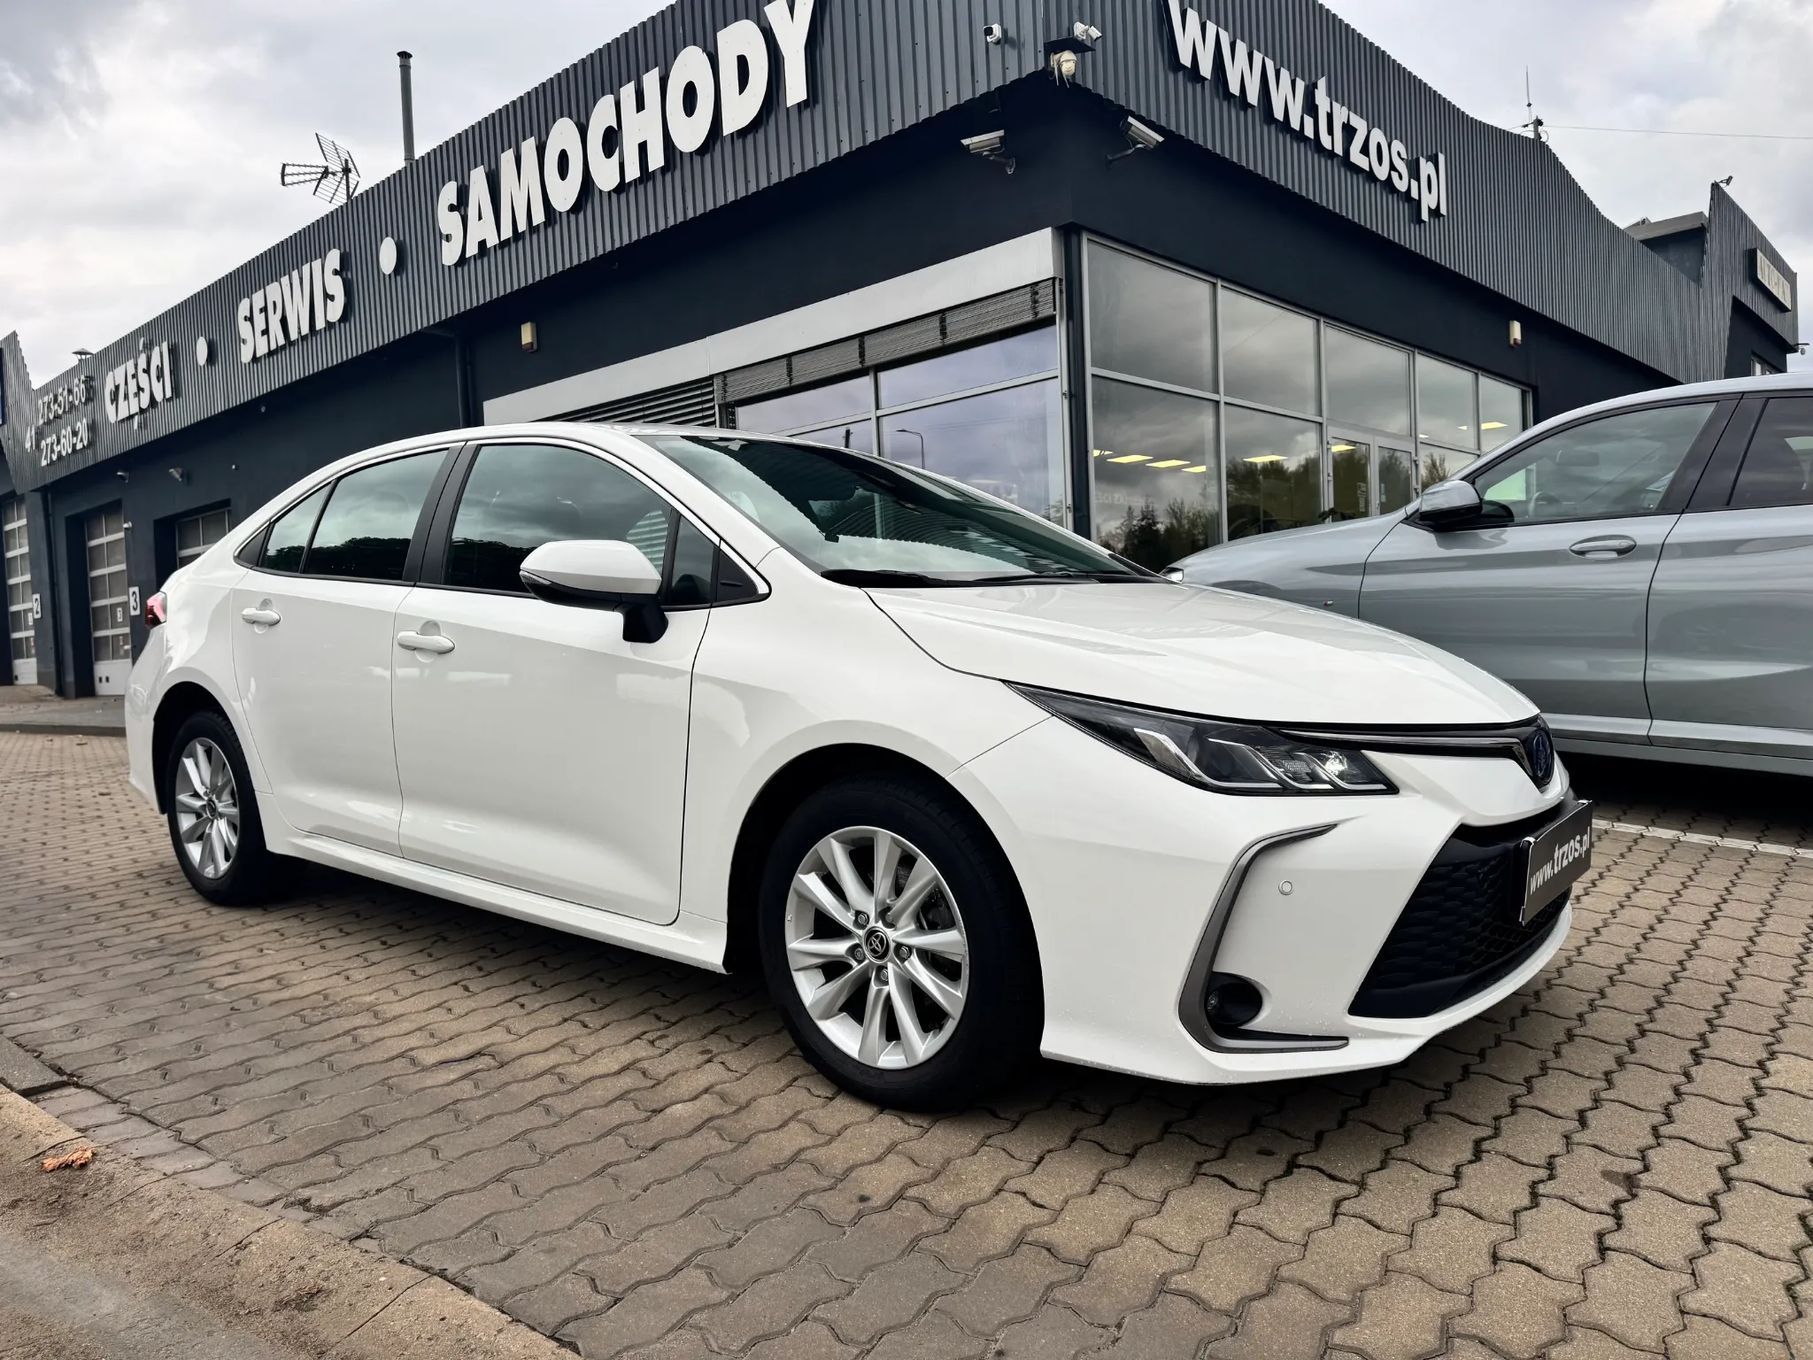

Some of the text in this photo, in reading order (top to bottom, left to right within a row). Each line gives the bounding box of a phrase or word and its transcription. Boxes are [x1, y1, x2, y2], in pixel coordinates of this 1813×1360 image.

[1166, 0, 1447, 222] www.trzos.pl
[104, 0, 815, 430] CZĘŚCI SERWIS SAMOCHODY
[38, 374, 86, 426] 273-51-66
[25, 417, 88, 467] 41 273-60-20
[132, 590, 138, 611] 3
[1531, 826, 1590, 893] www.trzos.pl
